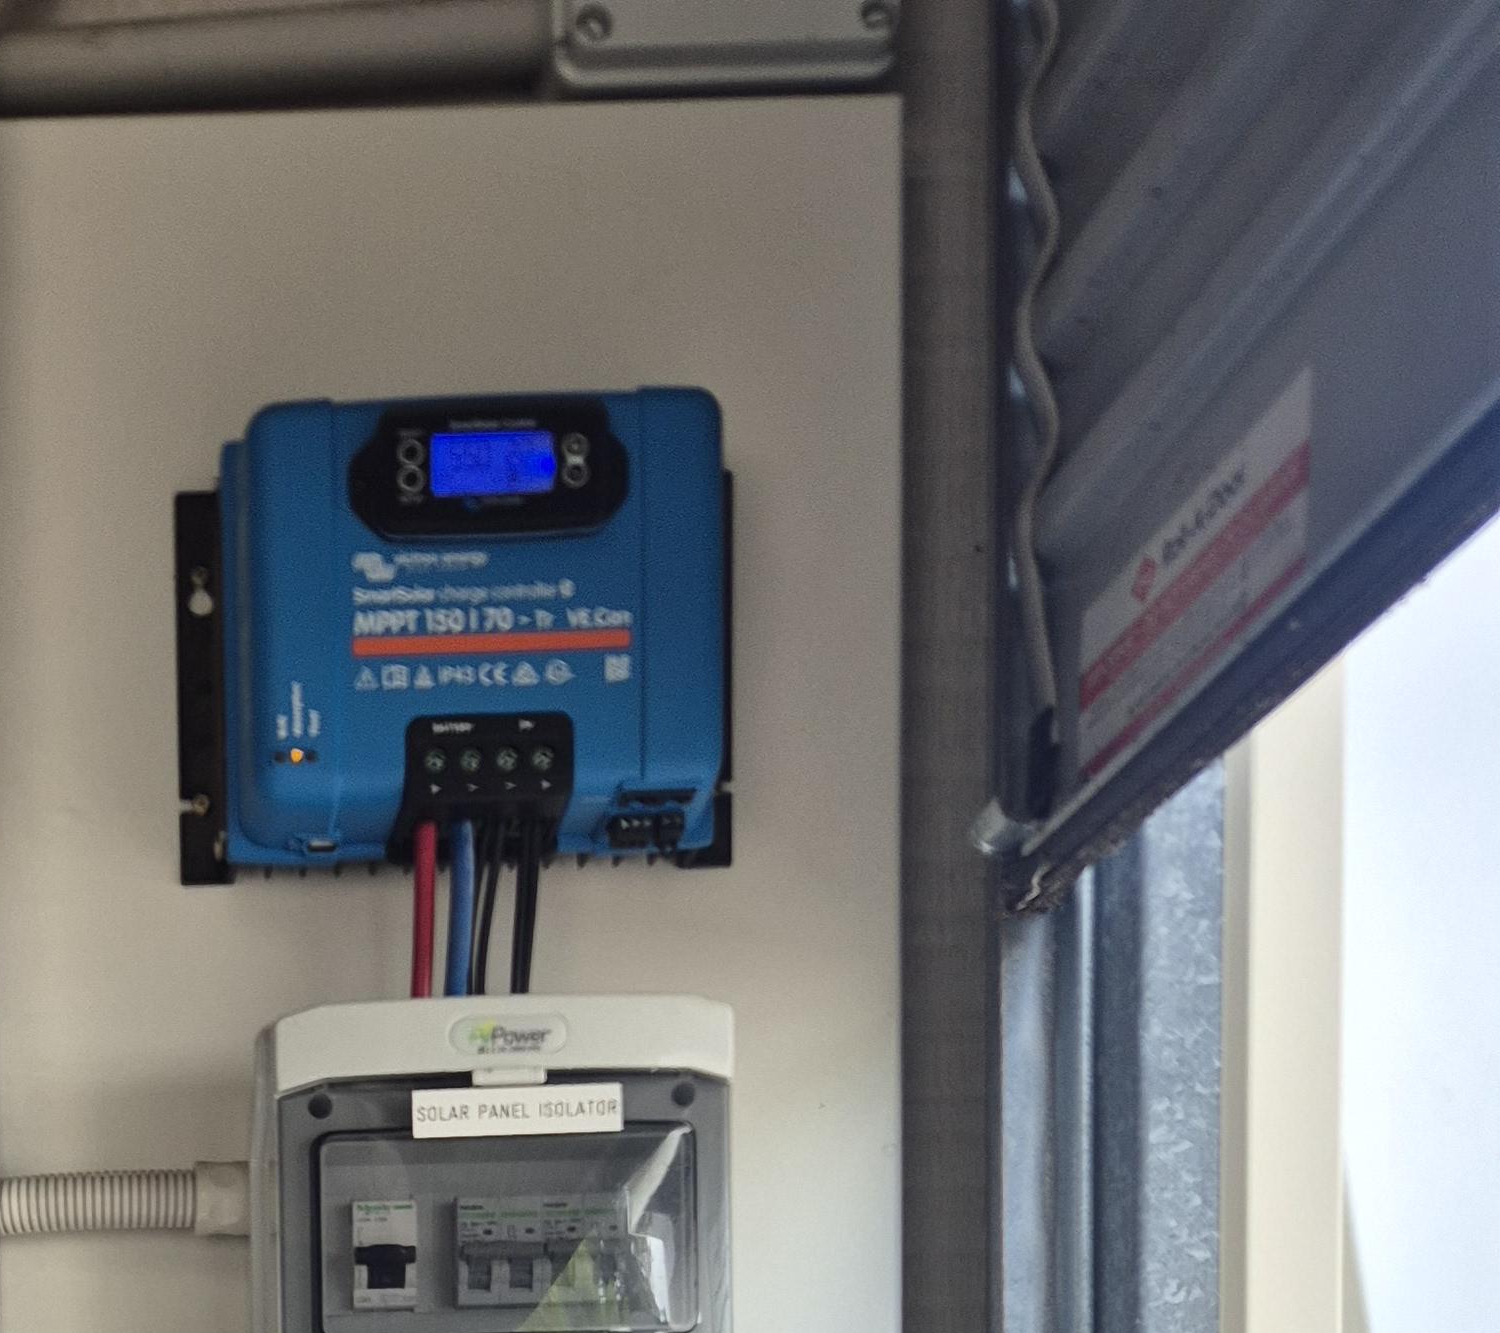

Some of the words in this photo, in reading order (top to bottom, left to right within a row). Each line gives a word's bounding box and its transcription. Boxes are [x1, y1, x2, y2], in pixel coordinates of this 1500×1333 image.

[354, 610, 420, 636] MPPT
[425, 608, 466, 633] 150
[482, 607, 514, 632] 70
[417, 1105, 470, 1122] SOLAR
[478, 1104, 529, 1119] PANEL
[539, 1099, 618, 1117] ISOLATOR
